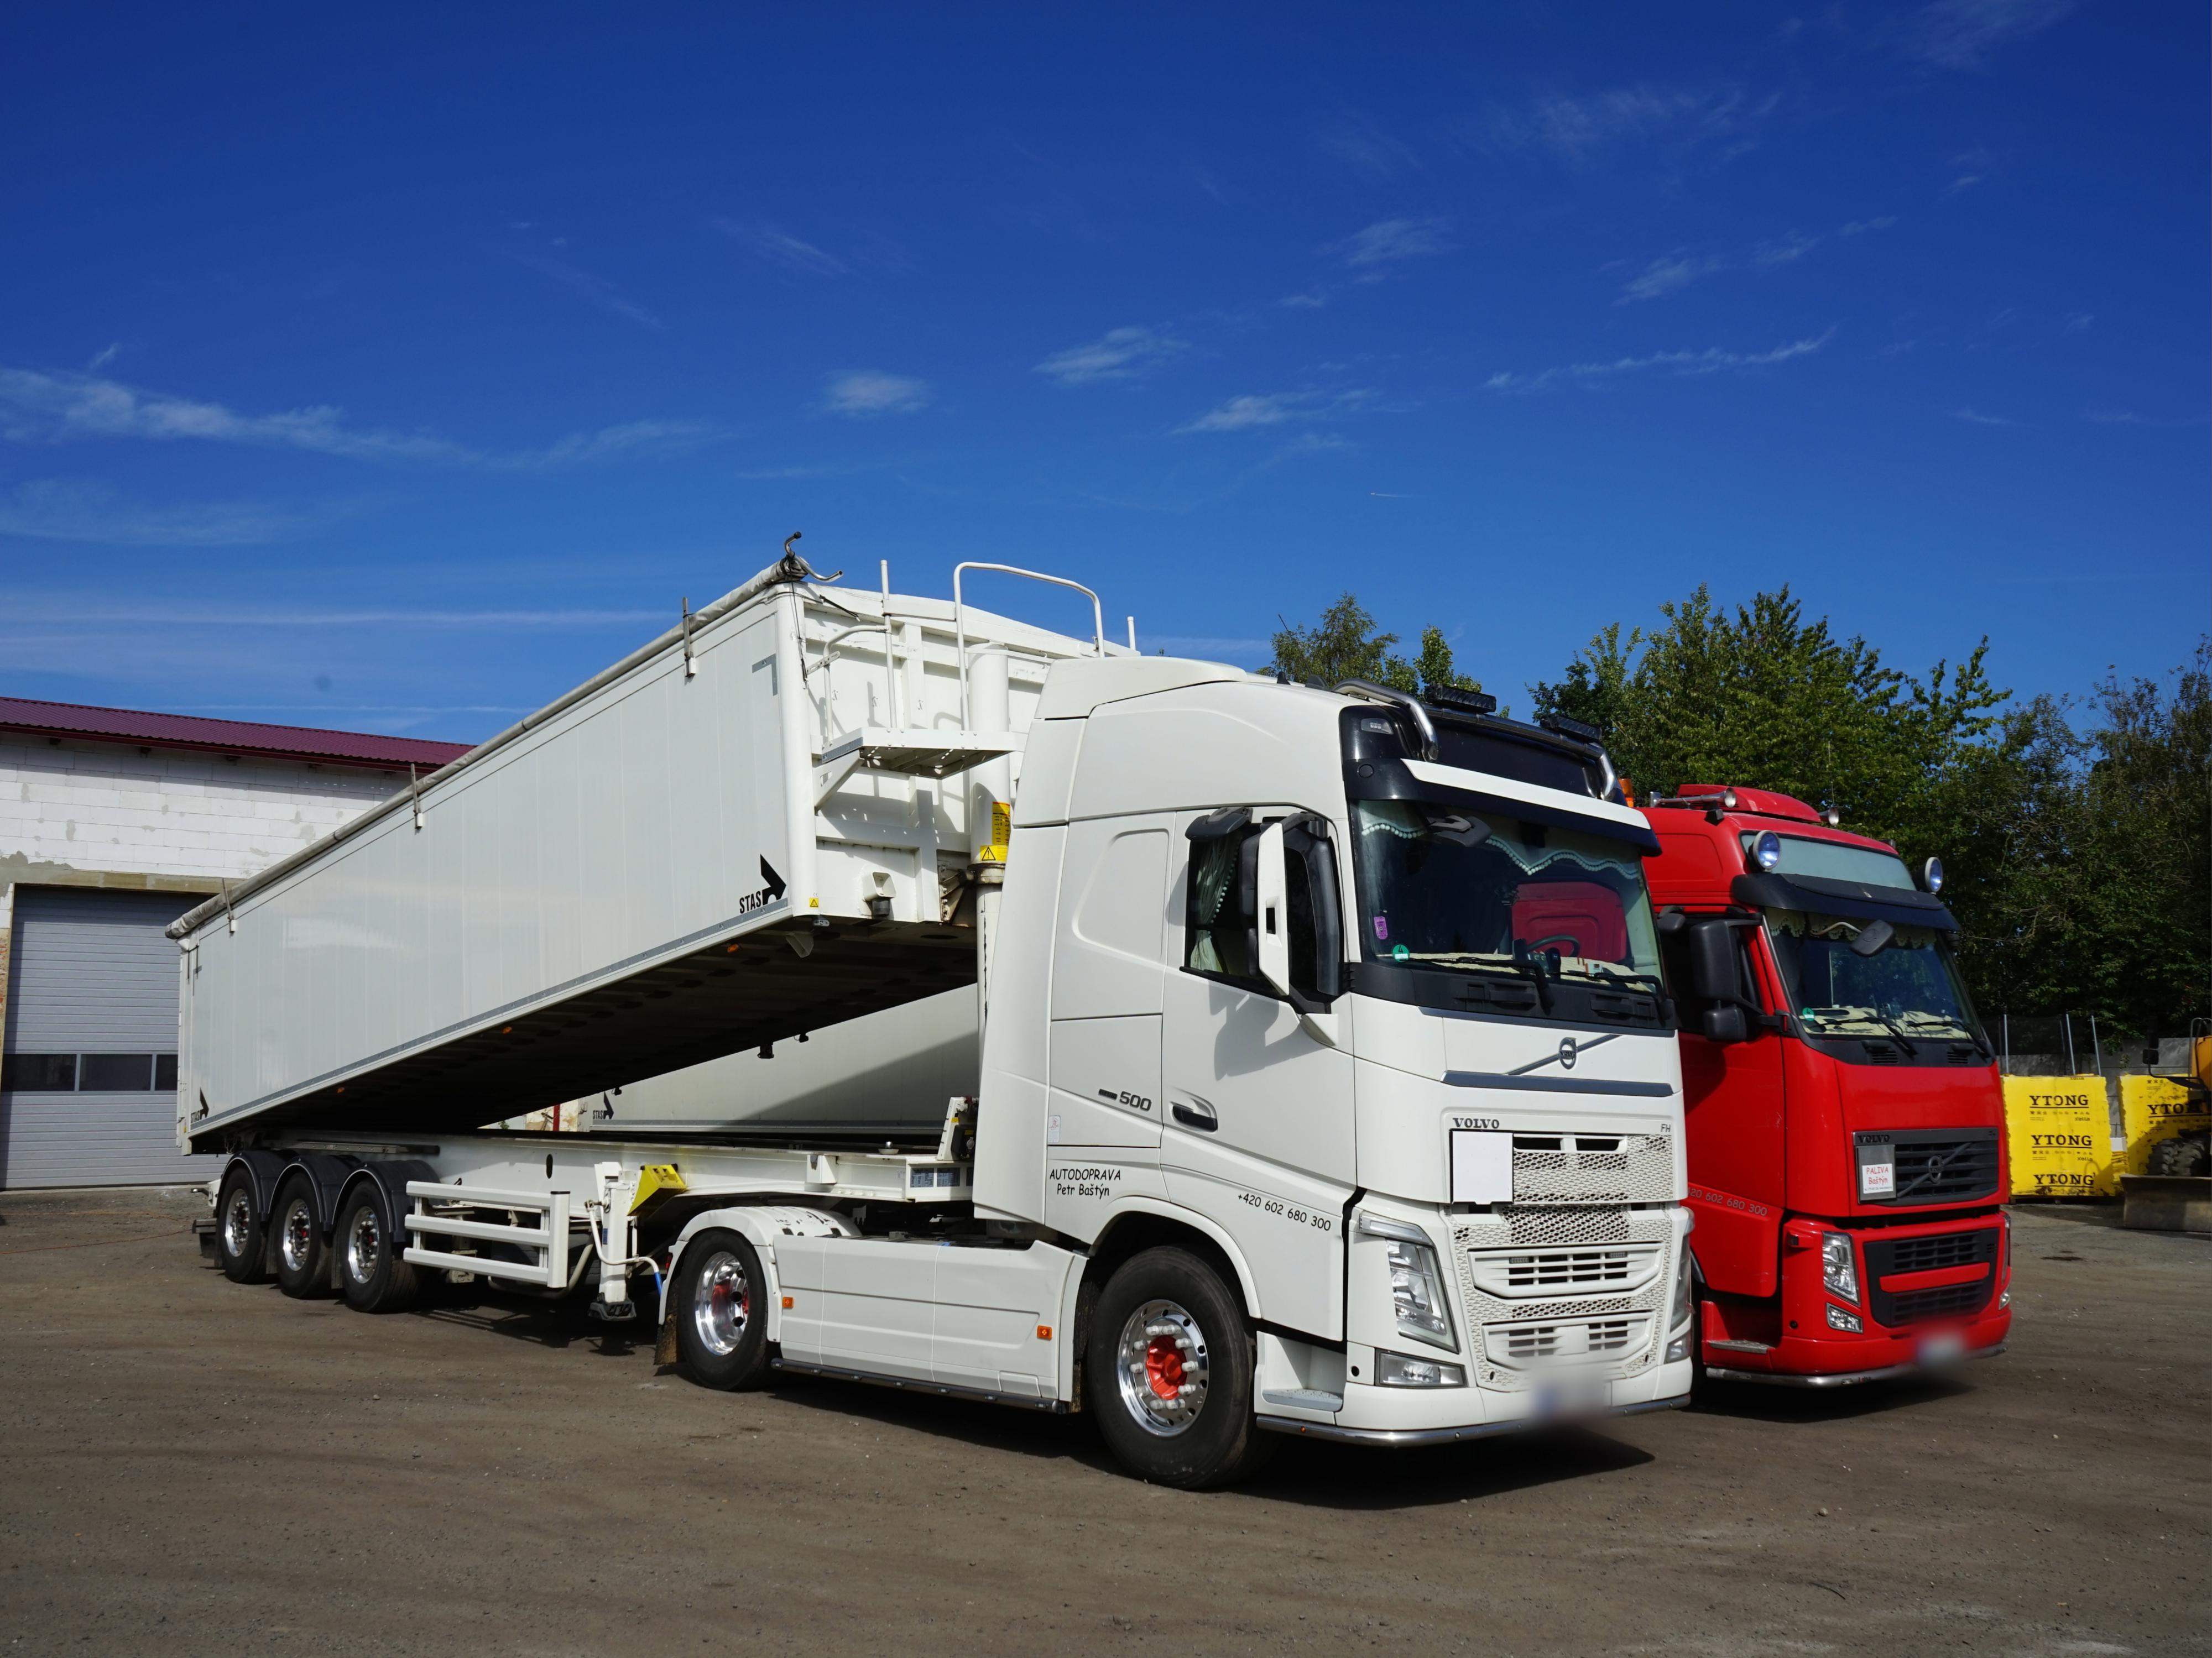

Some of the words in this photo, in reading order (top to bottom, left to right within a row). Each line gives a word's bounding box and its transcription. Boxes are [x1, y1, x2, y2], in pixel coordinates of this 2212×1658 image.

[739, 891, 761, 913] STAS
[1398, 945, 1404, 954] 4
[1119, 1091, 1152, 1111] 500
[2029, 1095, 2089, 1106] YTONG
[593, 1110, 603, 1120] STAS
[2147, 1103, 2203, 1115] YTO
[191, 1110, 200, 1123] STAS
[1452, 1118, 1500, 1129] VOLVO
[1661, 1123, 1671, 1132] FH
[1858, 1135, 1890, 1143] VOLVO
[2031, 1135, 2093, 1146] YTONG
[1050, 1168, 1121, 1180] AUTODOPRAVA
[1866, 1166, 1889, 1175] PALIVA
[2033, 1174, 2094, 1186] YTONG
[1057, 1183, 1075, 1195] Petr
[1079, 1183, 1109, 1200] Baštýn
[1688, 1188, 1702, 1198] 20
[1705, 1192, 1723, 1204] 602
[1726, 1198, 1745, 1210] 680
[1749, 1204, 1767, 1216] 300
[1238, 1193, 1261, 1207] +420
[1265, 1200, 1284, 1215] 602
[1287, 1208, 1307, 1223] 680
[1311, 1216, 1331, 1231] 300
